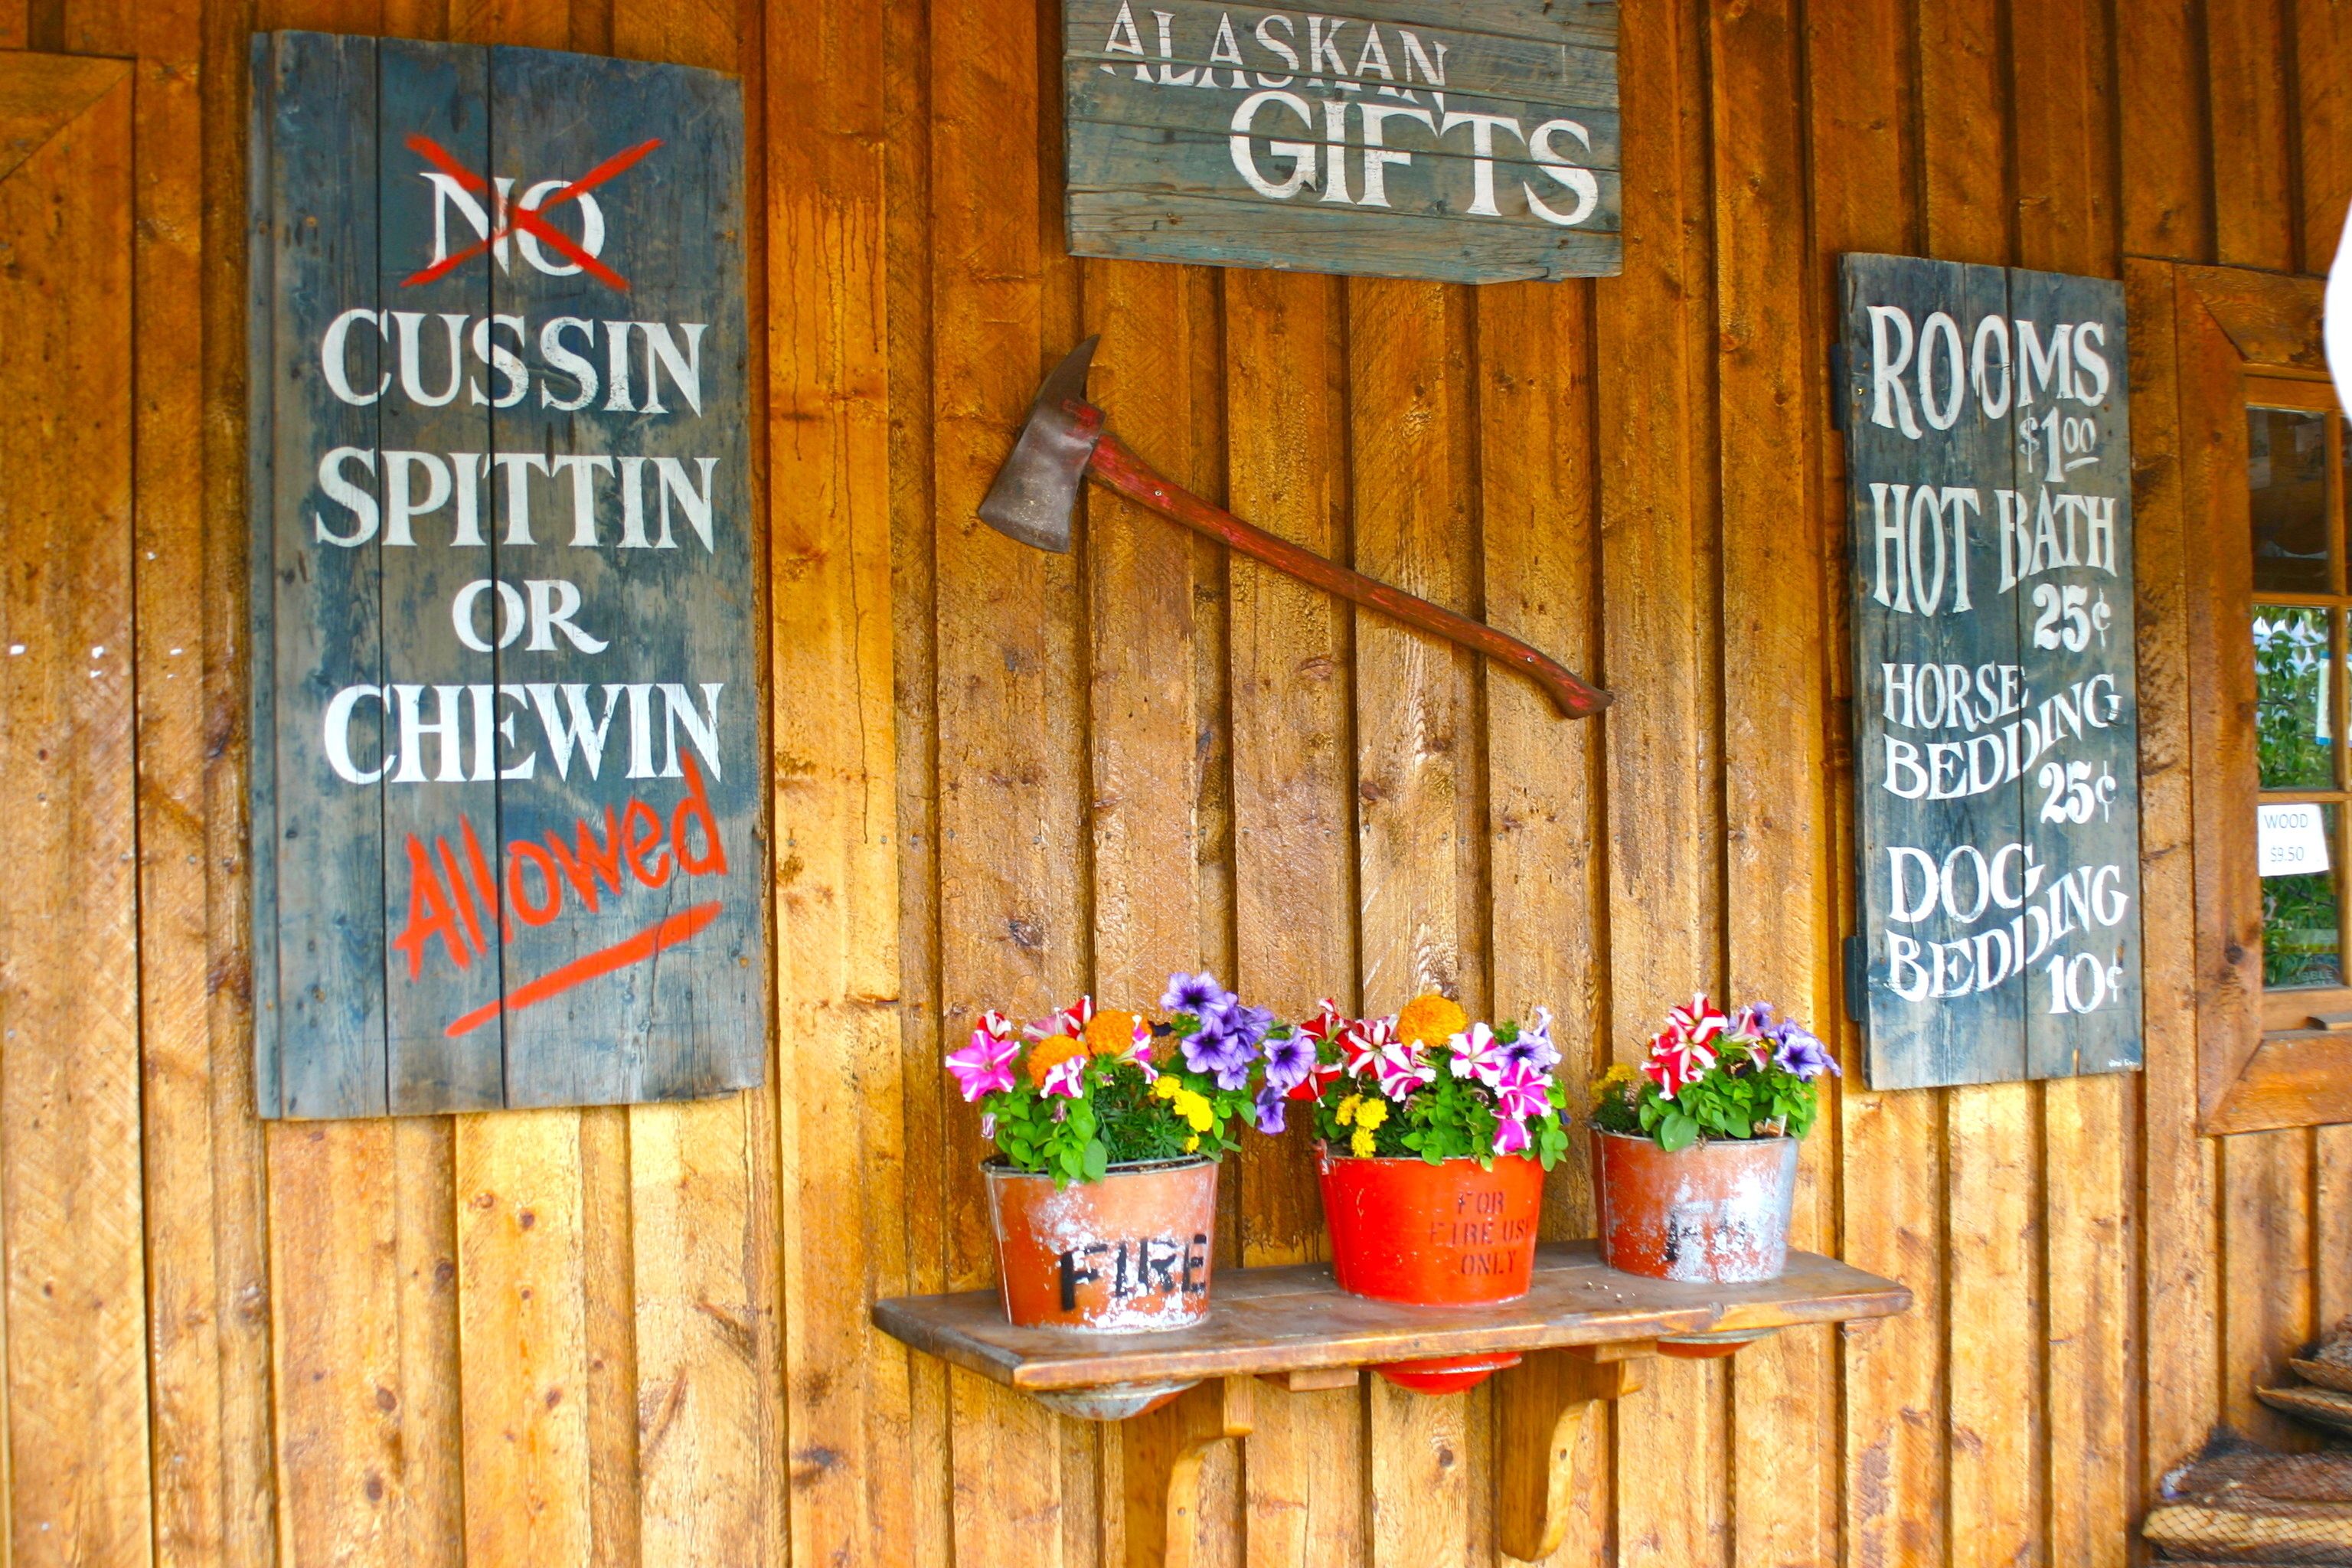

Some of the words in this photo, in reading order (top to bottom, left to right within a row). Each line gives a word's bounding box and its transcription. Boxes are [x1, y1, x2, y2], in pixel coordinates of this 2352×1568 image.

[1099, 0, 1449, 113] ALASKAN
[1230, 90, 1599, 226] GIFTS
[419, 172, 606, 276] NO
[321, 309, 709, 418] CUSSIN
[1867, 305, 2110, 440] ROOMS
[315, 447, 720, 554] SPITTIN
[1868, 482, 1981, 618] HOT
[1994, 484, 2118, 595] BATH
[452, 579, 609, 654] OR
[2033, 583, 2112, 653] 25¢
[324, 682, 724, 785] CHEWIN
[1881, 661, 2028, 733] HORSE
[1882, 673, 2123, 801] BEDDING
[2038, 760, 2118, 825] 25¢
[2264, 813, 2309, 828] WOOD
[393, 746, 729, 983] Allowed
[1886, 843, 2046, 923] DOG
[1885, 864, 2130, 1002] BEDDING
[2045, 952, 2124, 1014] 10¢
[1430, 1221, 1494, 1246] FIRE
[1458, 1191, 1504, 1215] FOR
[1059, 1233, 1207, 1312] FIRE
[1461, 1250, 1517, 1276] ONLY
